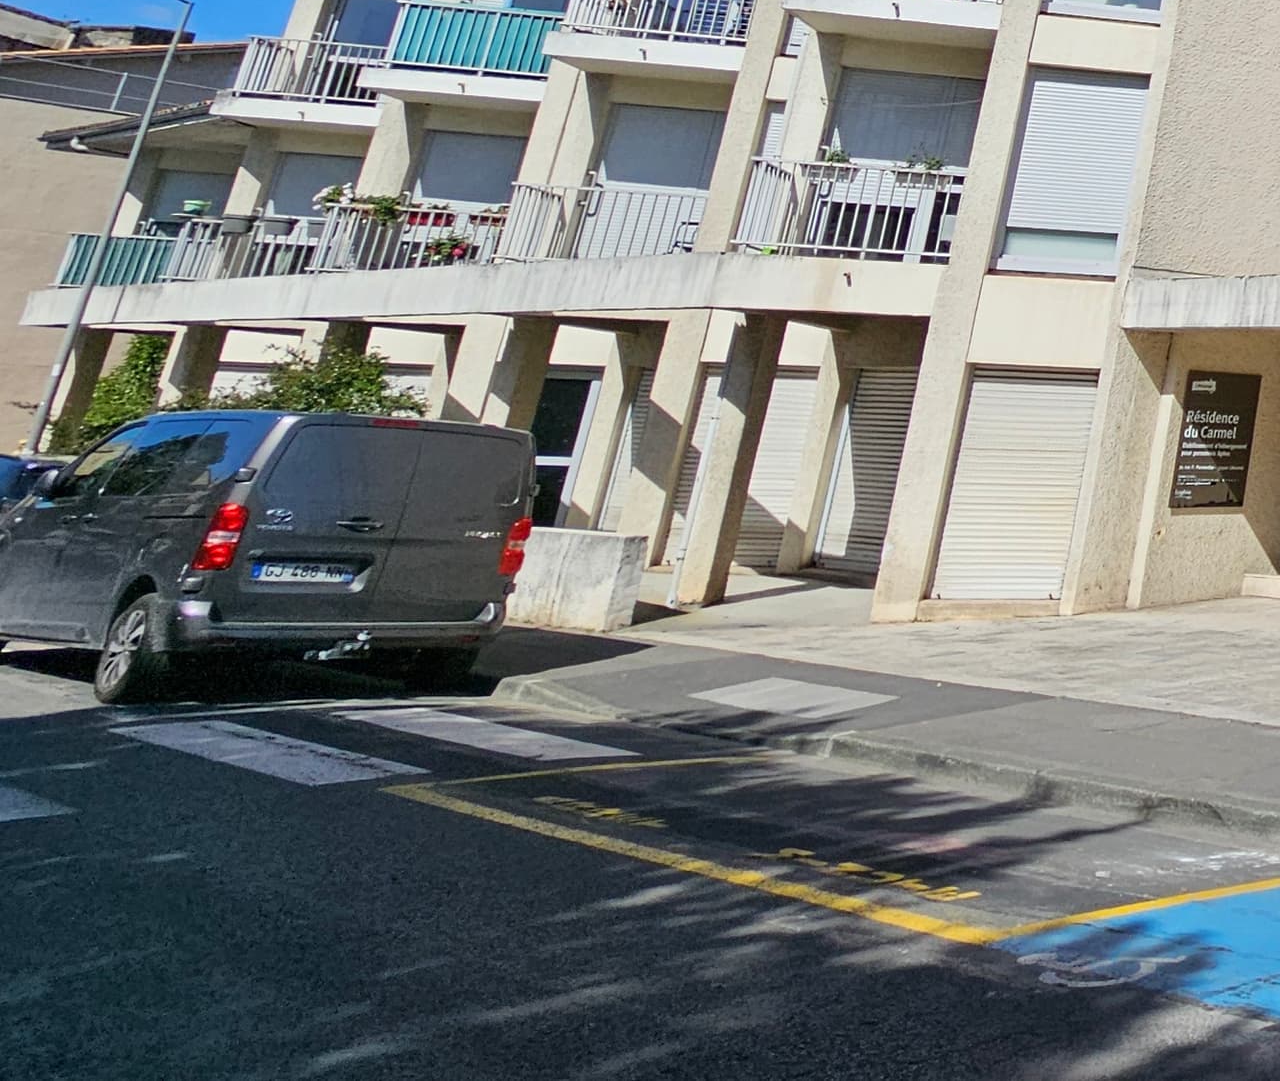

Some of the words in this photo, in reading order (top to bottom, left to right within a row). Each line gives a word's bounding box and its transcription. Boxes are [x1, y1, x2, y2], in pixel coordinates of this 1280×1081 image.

[1186, 410, 1240, 424] Résidence
[1184, 425, 1198, 439] du
[1200, 426, 1237, 439] Carmel
